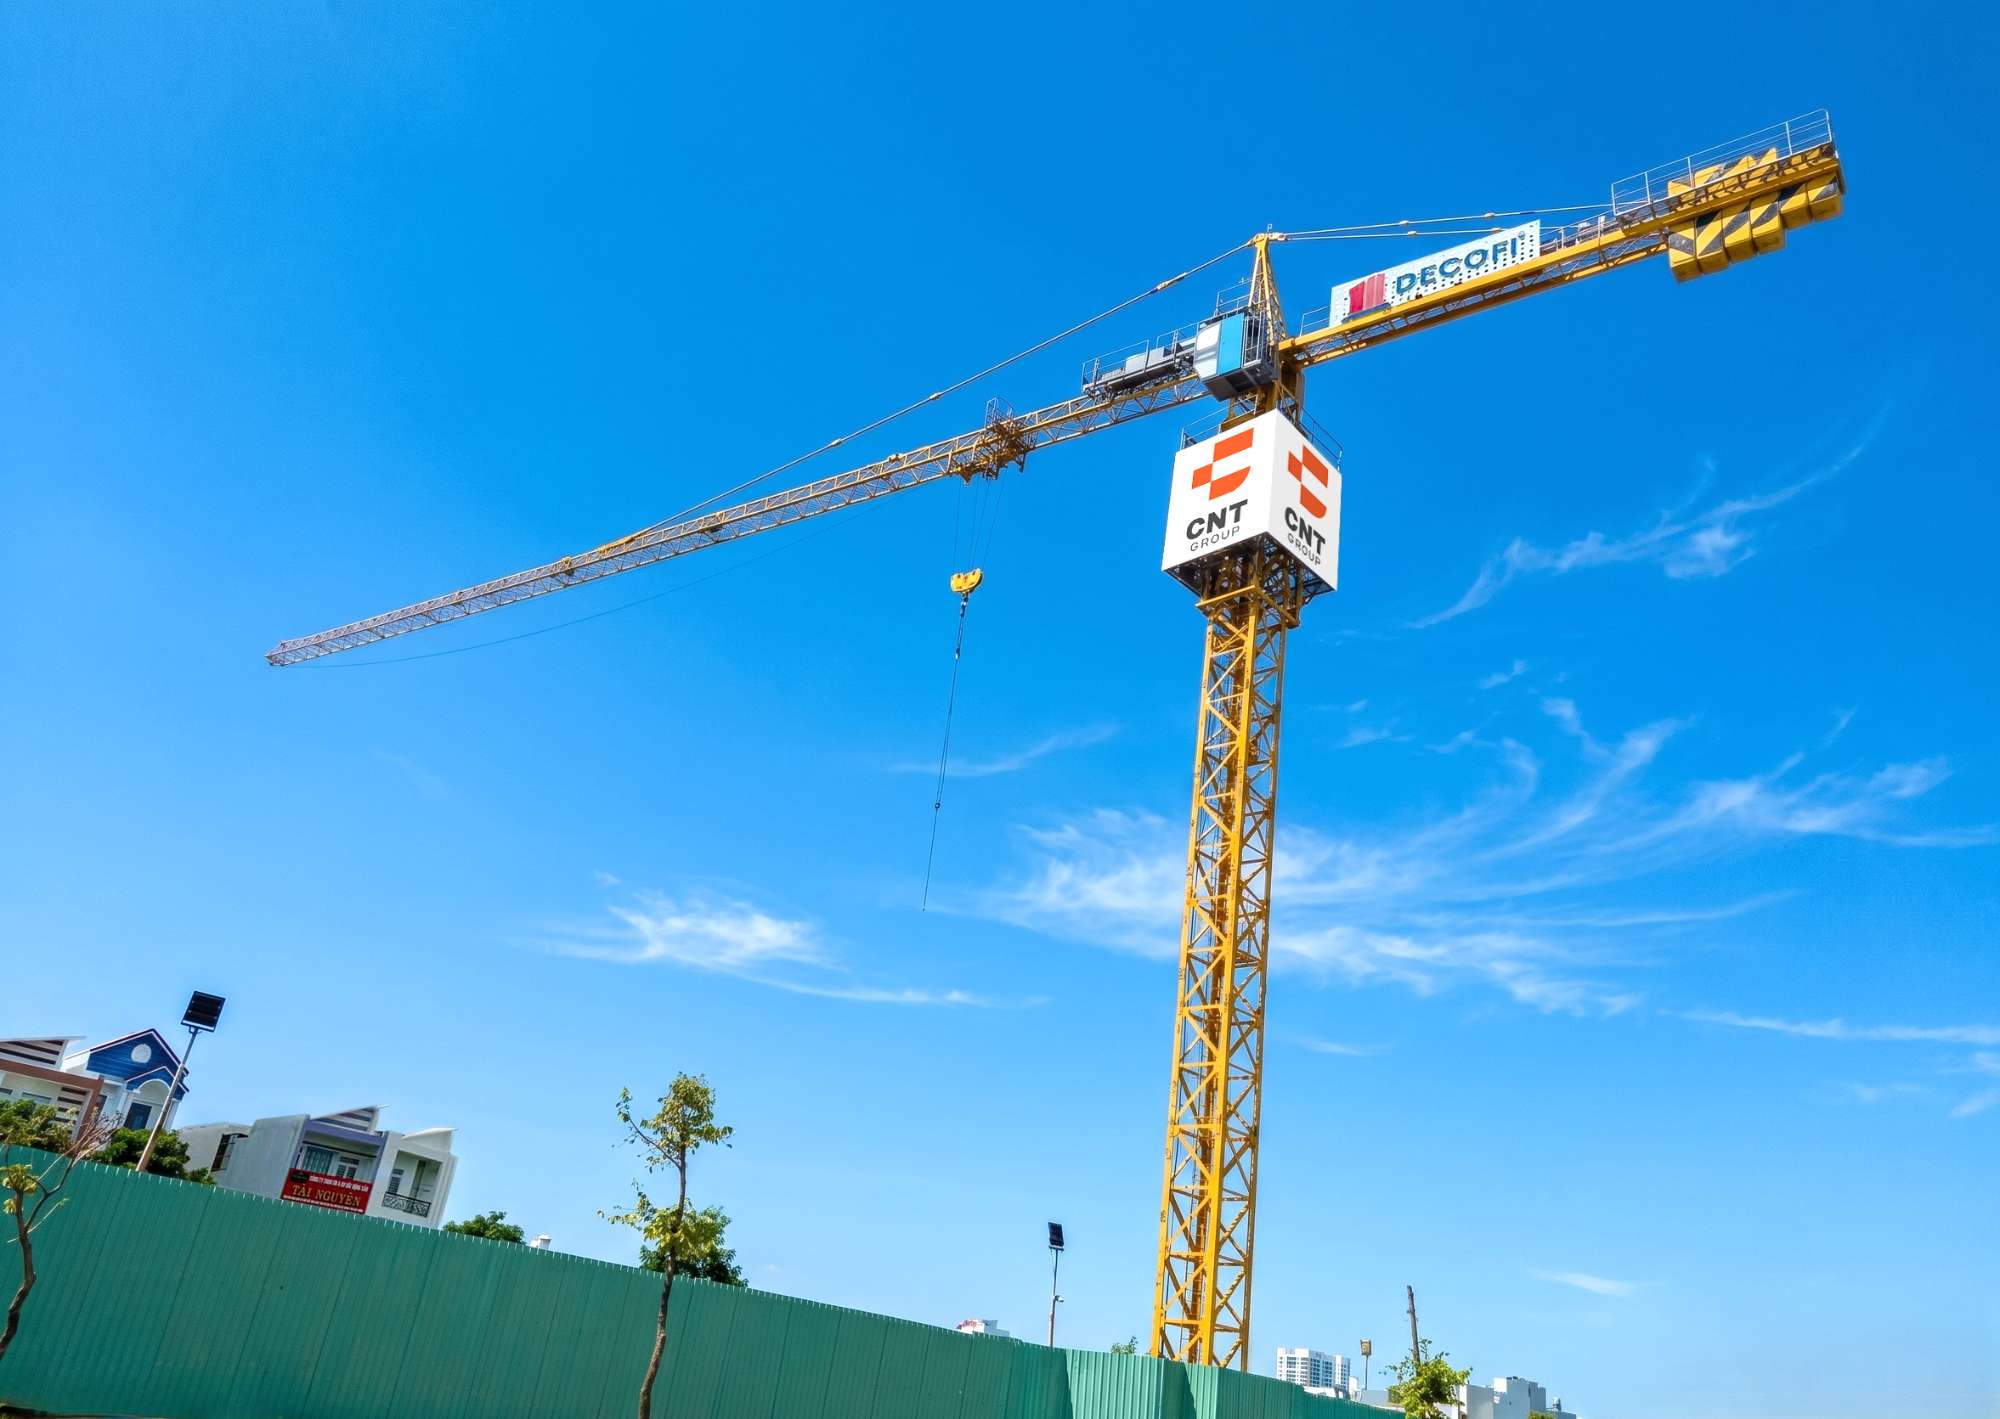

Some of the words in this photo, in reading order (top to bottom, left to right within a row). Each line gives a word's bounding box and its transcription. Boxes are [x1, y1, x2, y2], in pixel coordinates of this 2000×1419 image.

[1186, 498, 1248, 540] CNT
[1284, 506, 1326, 556] CNT
[1190, 525, 1240, 552] GROUP
[1287, 532, 1321, 567] GROUP
